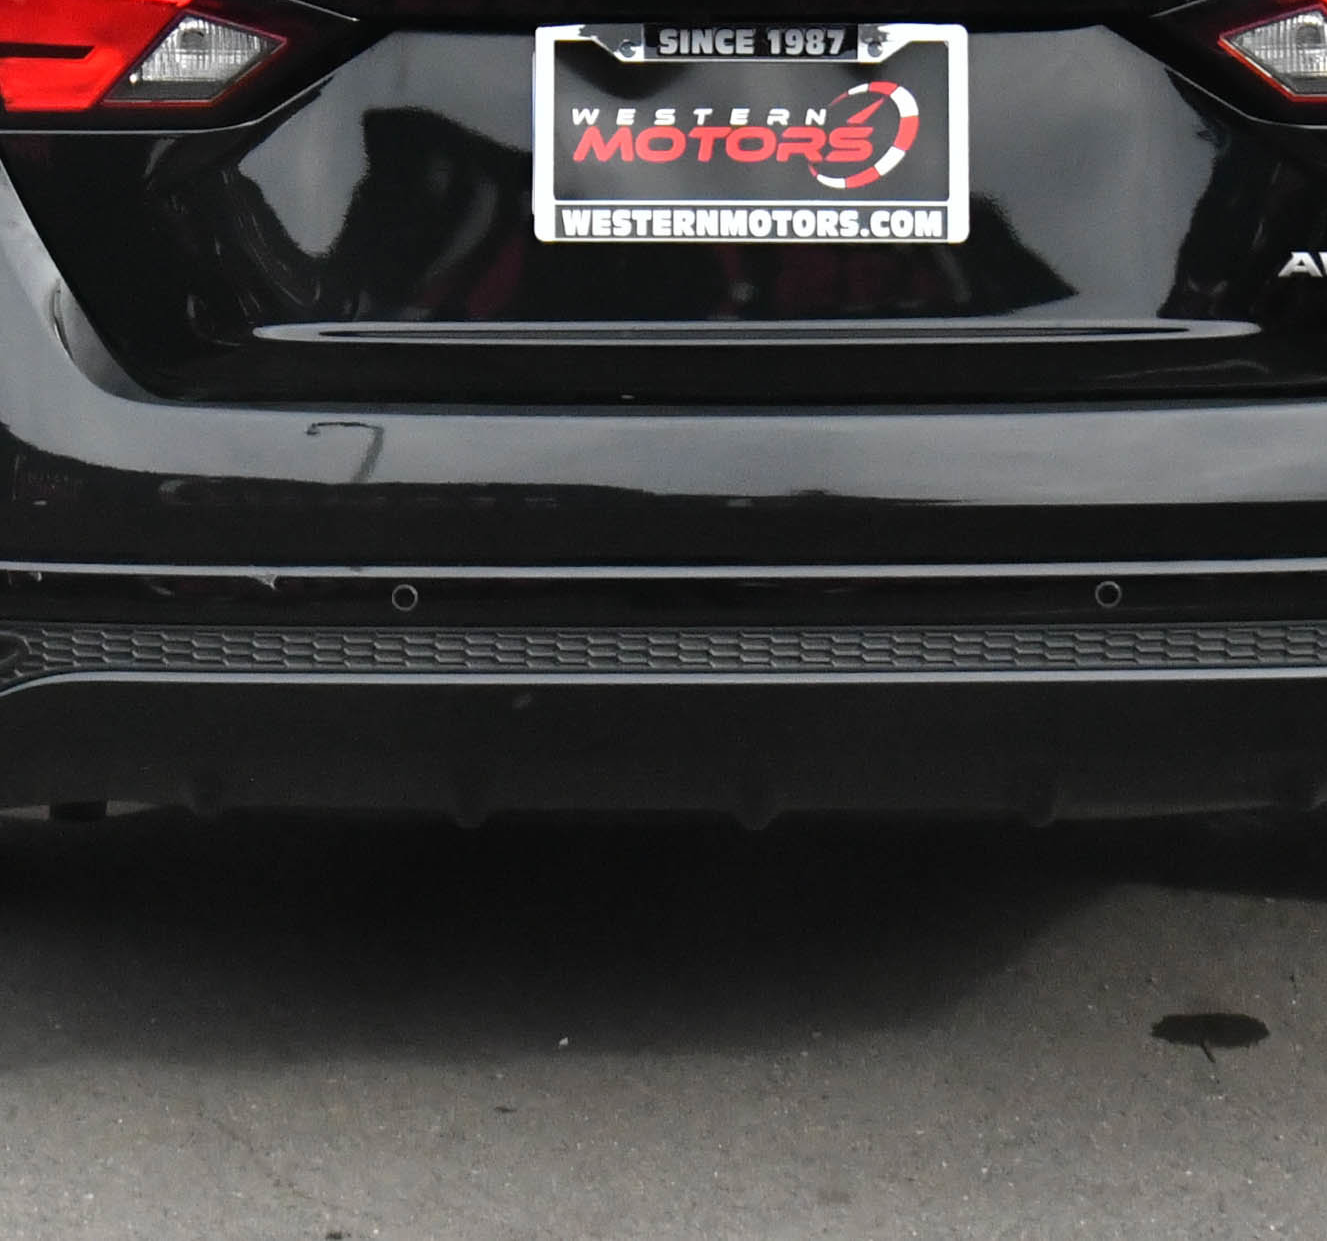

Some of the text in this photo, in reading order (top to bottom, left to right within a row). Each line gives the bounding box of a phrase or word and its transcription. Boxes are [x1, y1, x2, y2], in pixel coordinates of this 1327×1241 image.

[659, 28, 845, 56] SINCE 1987
[572, 108, 827, 126] WESTERN
[573, 126, 874, 163] MOTORS
[561, 208, 942, 238] WESTERNMOTORS.COM
